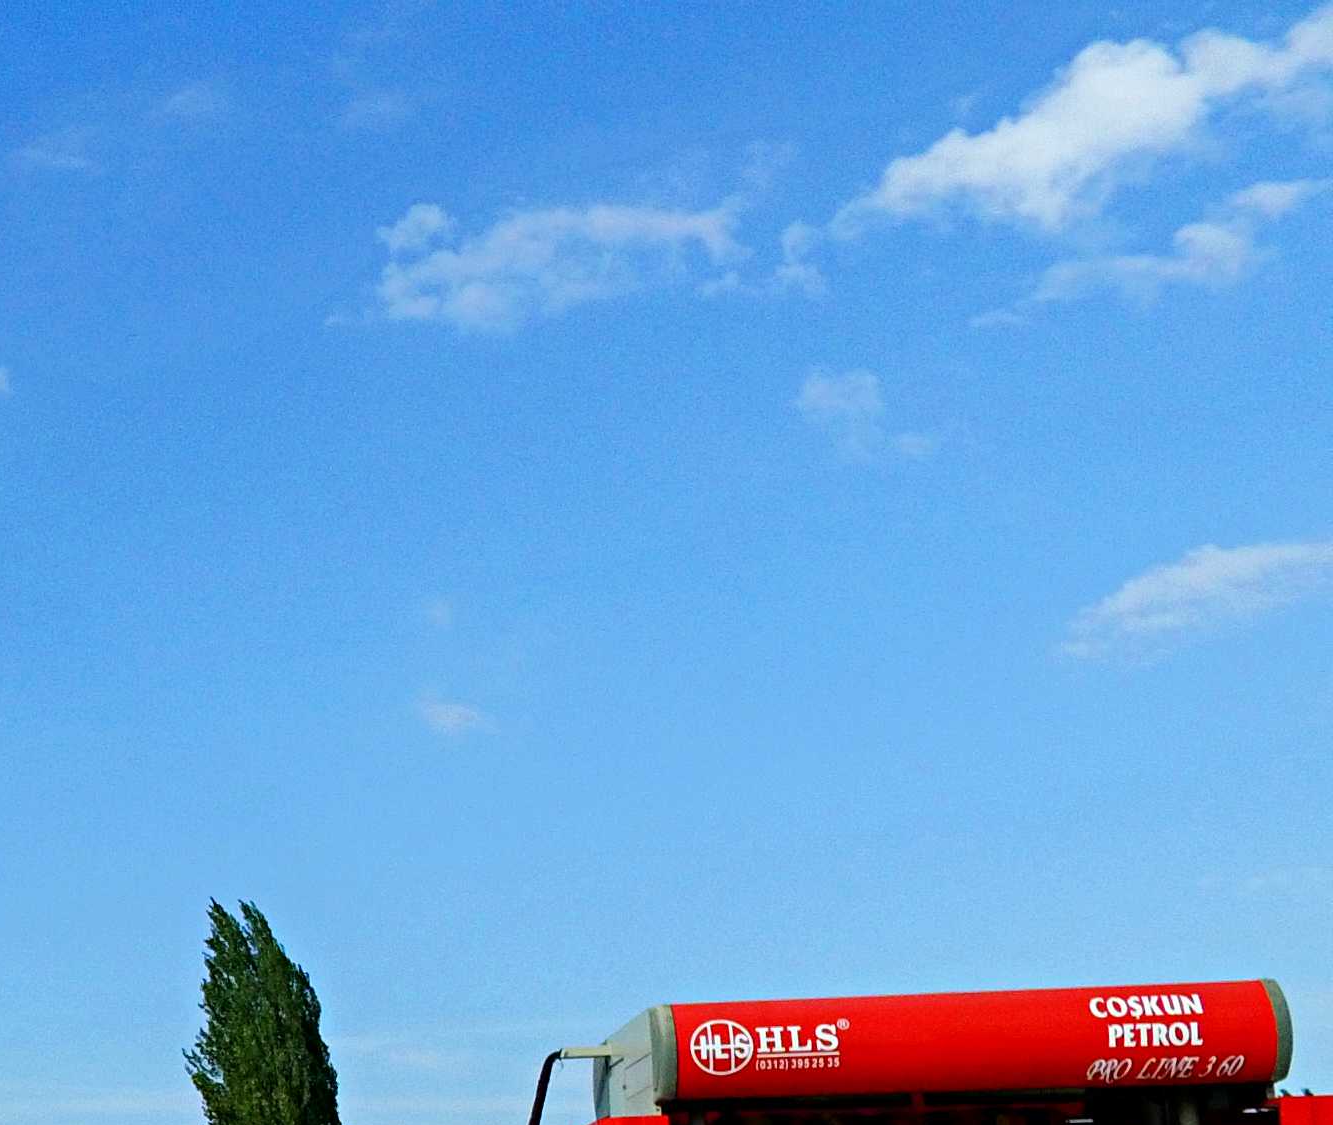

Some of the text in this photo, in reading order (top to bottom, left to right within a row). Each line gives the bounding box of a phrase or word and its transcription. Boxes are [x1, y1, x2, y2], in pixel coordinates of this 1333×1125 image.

[1088, 993, 1204, 1020] COŞKUN
[755, 1023, 839, 1053] HLS
[1108, 1022, 1204, 1048] PETROL
[755, 1058, 789, 1071] (0312)
[1086, 1058, 1133, 1084] PRO
[1136, 1056, 1200, 1080] LINE
